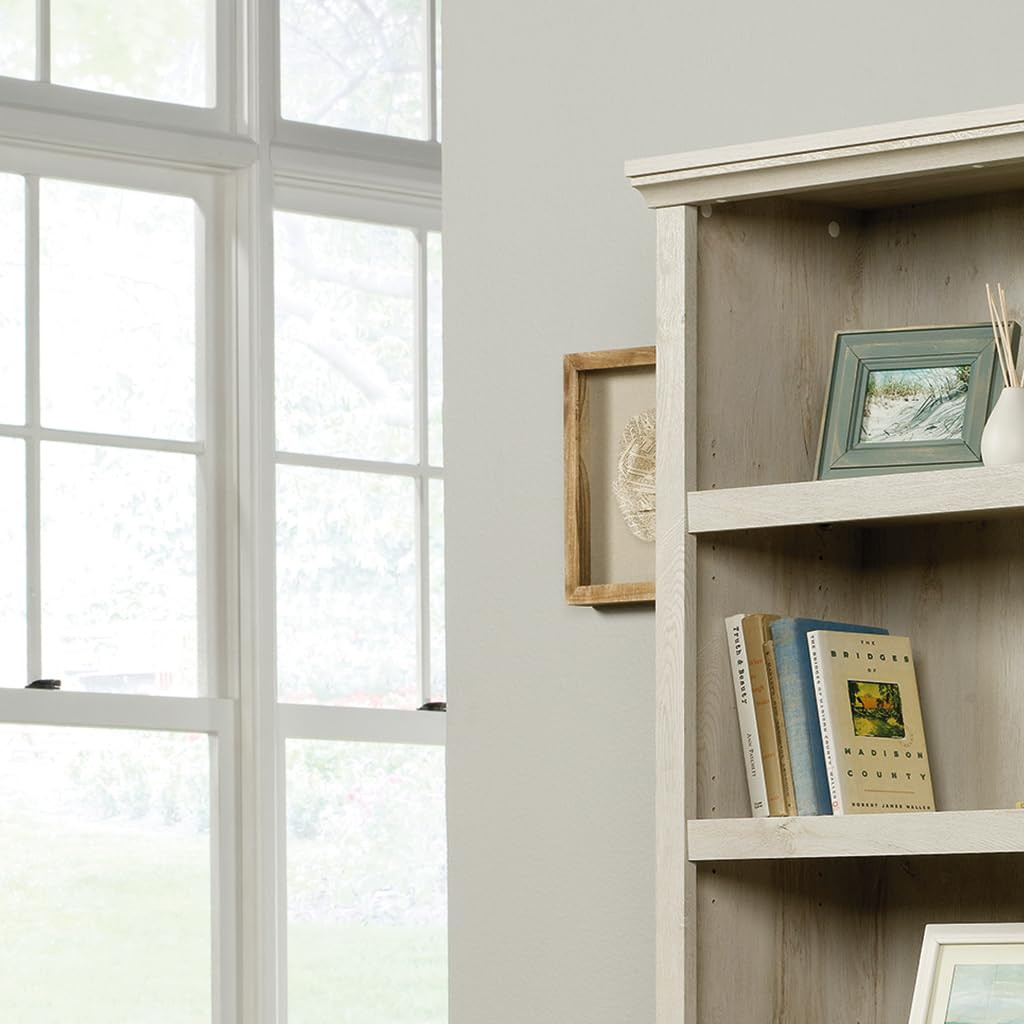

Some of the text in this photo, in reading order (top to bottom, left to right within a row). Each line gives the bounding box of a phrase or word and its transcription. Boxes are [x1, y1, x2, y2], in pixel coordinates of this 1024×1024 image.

[830, 650, 910, 663] BRIDGES
[732, 626, 742, 655] Truth
[738, 668, 748, 704] Beauty
[812, 651, 821, 684] BRIDGES
[844, 747, 924, 759] MADISON
[847, 769, 927, 781] COUNTY
